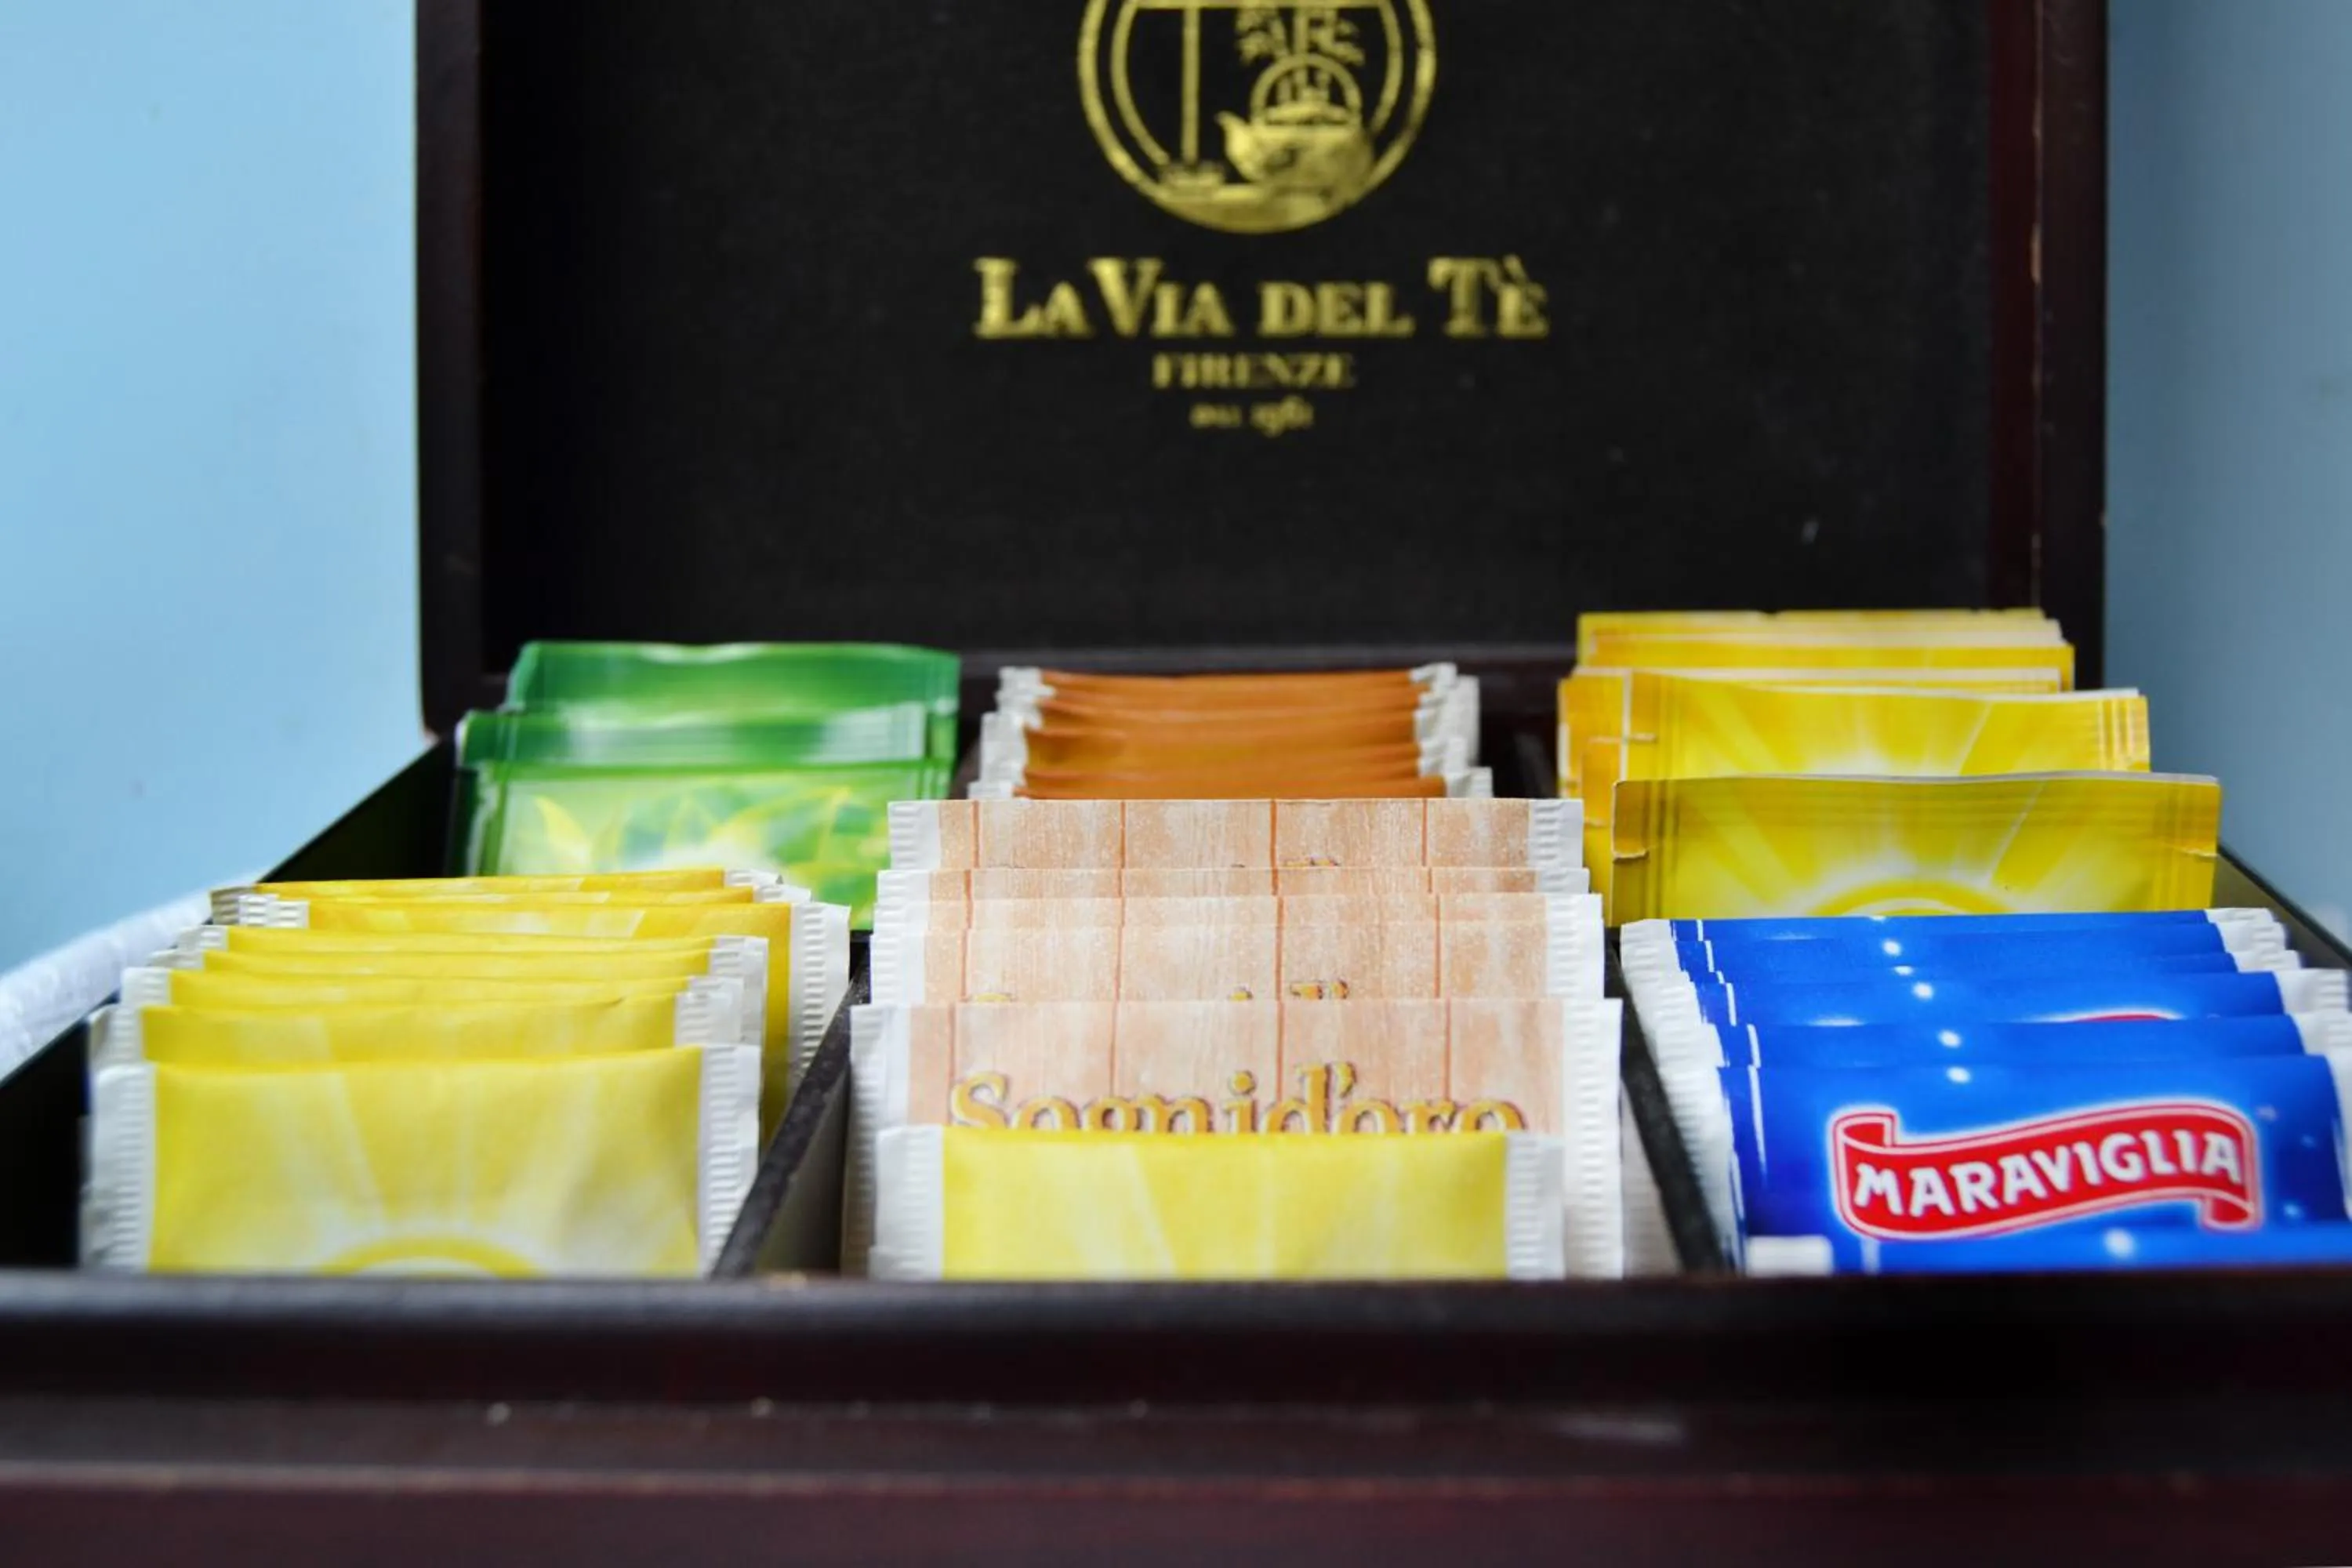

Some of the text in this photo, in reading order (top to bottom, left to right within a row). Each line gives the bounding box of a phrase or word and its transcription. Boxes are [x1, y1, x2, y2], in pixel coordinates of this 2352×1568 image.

[1258, 282, 1414, 336] DEL
[1428, 255, 1548, 336] TÈ
[1152, 353, 1354, 388] FIRENZE
[1855, 1130, 2241, 1216] MARAVIGLIA
